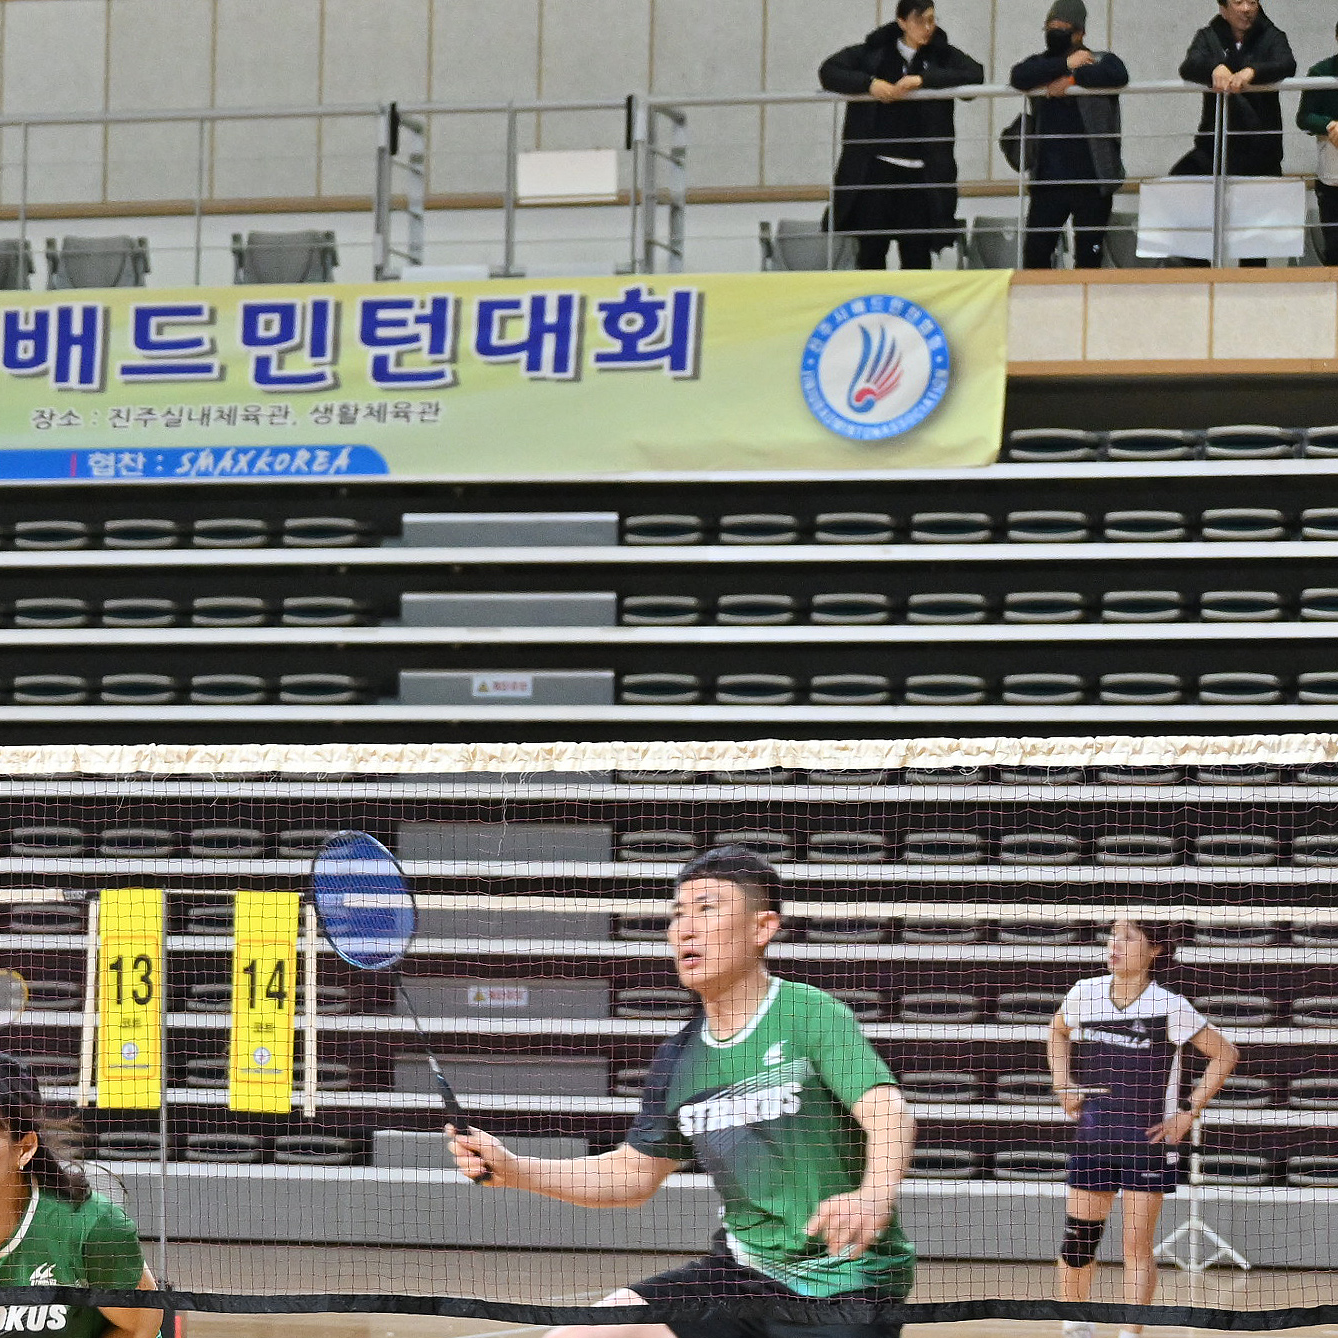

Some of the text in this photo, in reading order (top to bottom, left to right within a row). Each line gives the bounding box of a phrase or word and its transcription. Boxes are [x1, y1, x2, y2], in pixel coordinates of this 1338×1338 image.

[0, 286, 694, 390] 배드민턴대회
[31, 408, 83, 430] 장소
[309, 401, 441, 425] 생활체육관
[88, 451, 147, 477] 협찬
[109, 953, 154, 1006] 13
[242, 958, 289, 1010] 14
